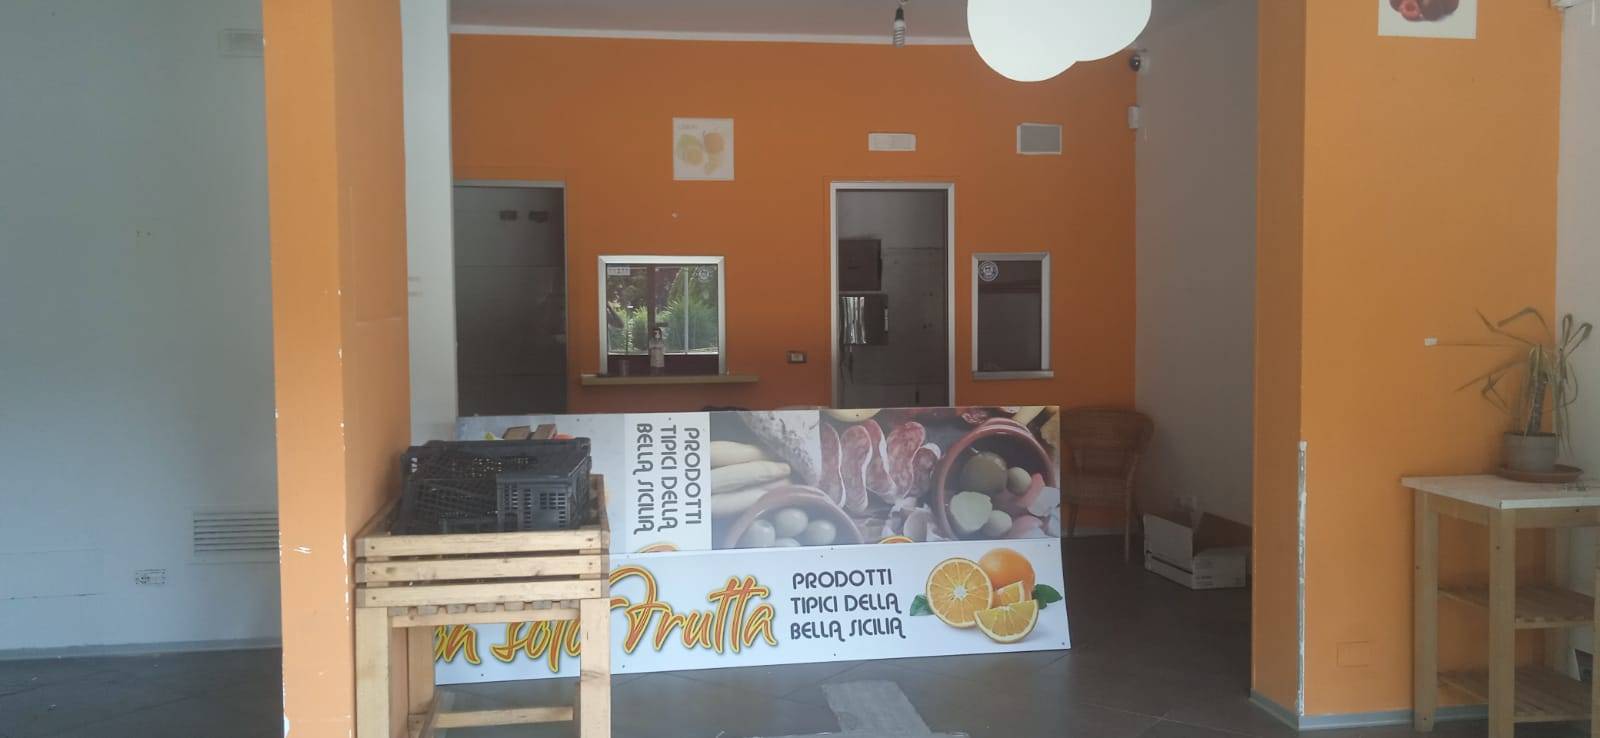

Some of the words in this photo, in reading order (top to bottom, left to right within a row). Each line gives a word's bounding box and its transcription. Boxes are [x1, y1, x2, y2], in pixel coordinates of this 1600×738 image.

[632, 423, 654, 476] BELLA
[660, 424, 677, 470] TIPICI
[684, 427, 702, 524] PRODOTTI
[633, 479, 655, 535] SICILIA
[657, 476, 678, 532] DELLA
[790, 594, 838, 615] TIPICI
[844, 592, 902, 615] DELLA
[792, 568, 893, 590] PRODOTTI
[610, 566, 777, 653] Frutta
[790, 619, 846, 642] BELLA
[848, 617, 906, 639] SICILIA
